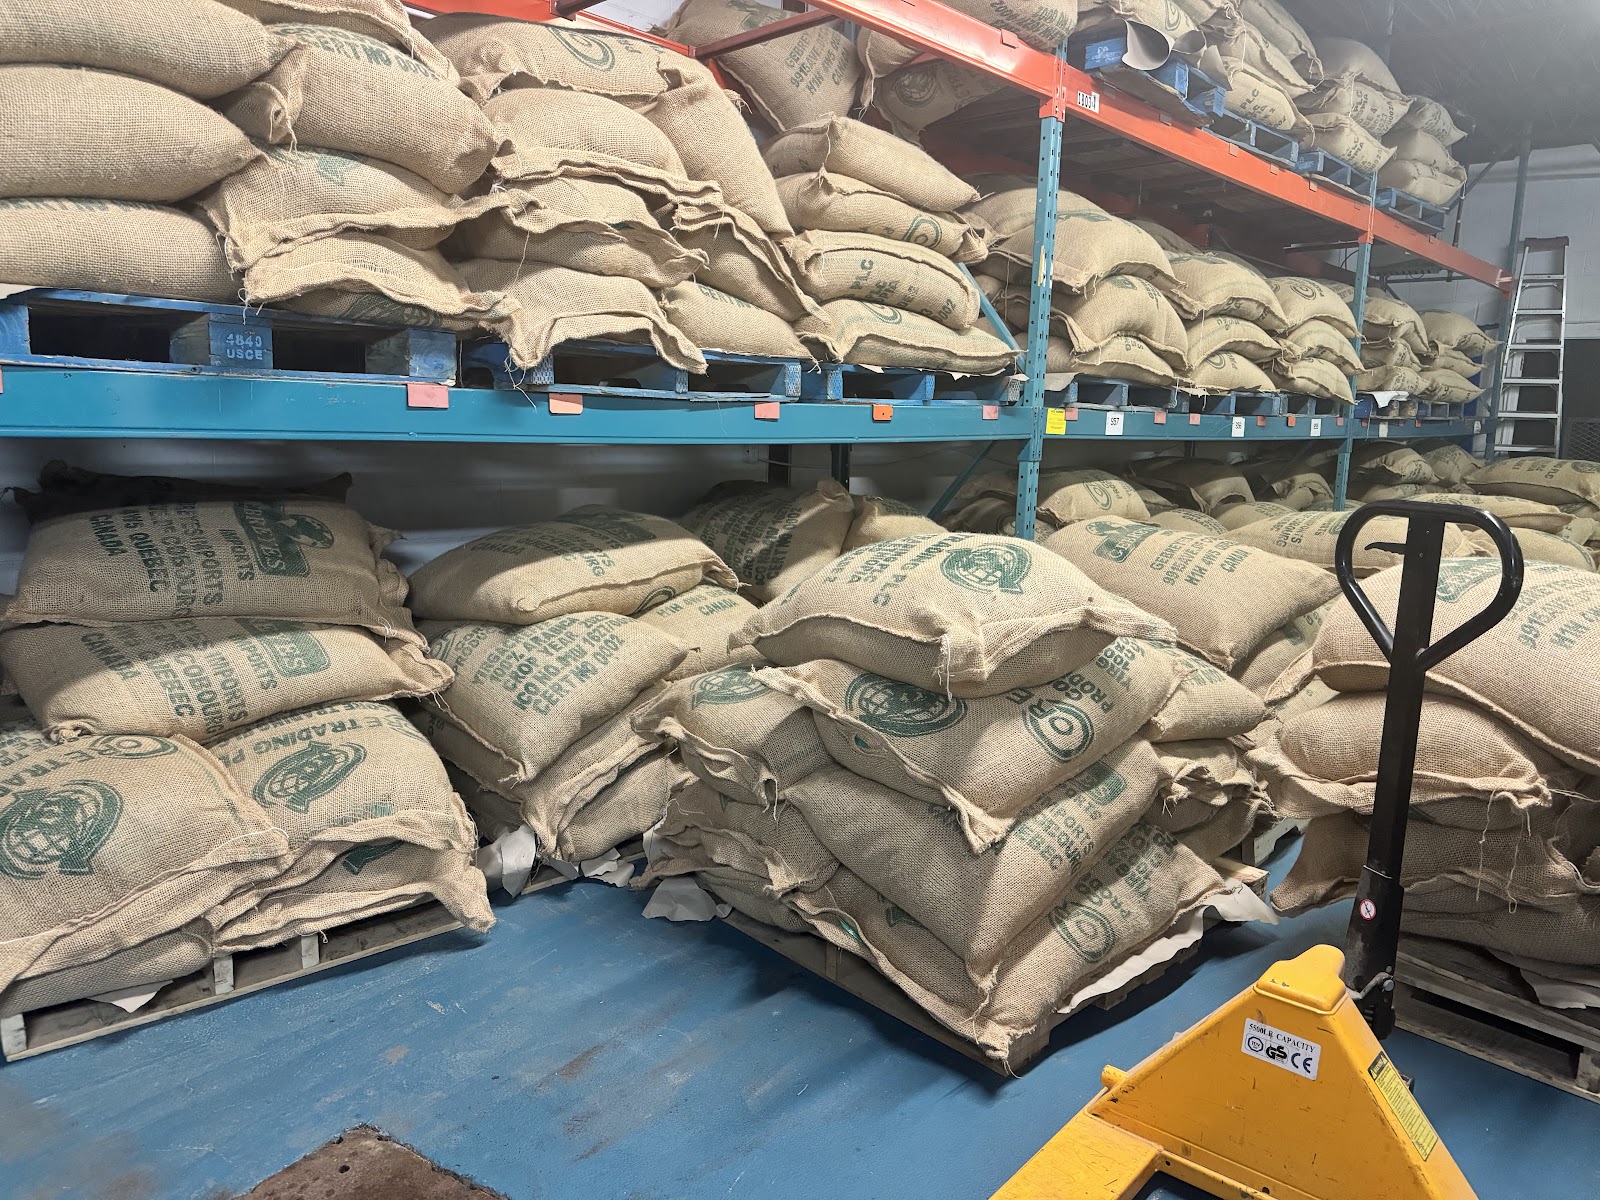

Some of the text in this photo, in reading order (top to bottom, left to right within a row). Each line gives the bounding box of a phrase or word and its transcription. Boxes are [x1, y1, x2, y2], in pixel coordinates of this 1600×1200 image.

[1240, 88, 1260, 110] PLC
[226, 332, 262, 348] 4840
[698, 598, 738, 617] CANADA
[501, 655, 539, 693] CROP
[541, 629, 580, 658] YEAR
[530, 672, 577, 716] CERT
[591, 632, 626, 667] 0002
[511, 680, 541, 711] ICO
[253, 718, 364, 756] TRADING
[1276, 1033, 1316, 1053] CAPACITY
[1265, 1044, 1288, 1060] GS
[1290, 1052, 1313, 1075] CE
